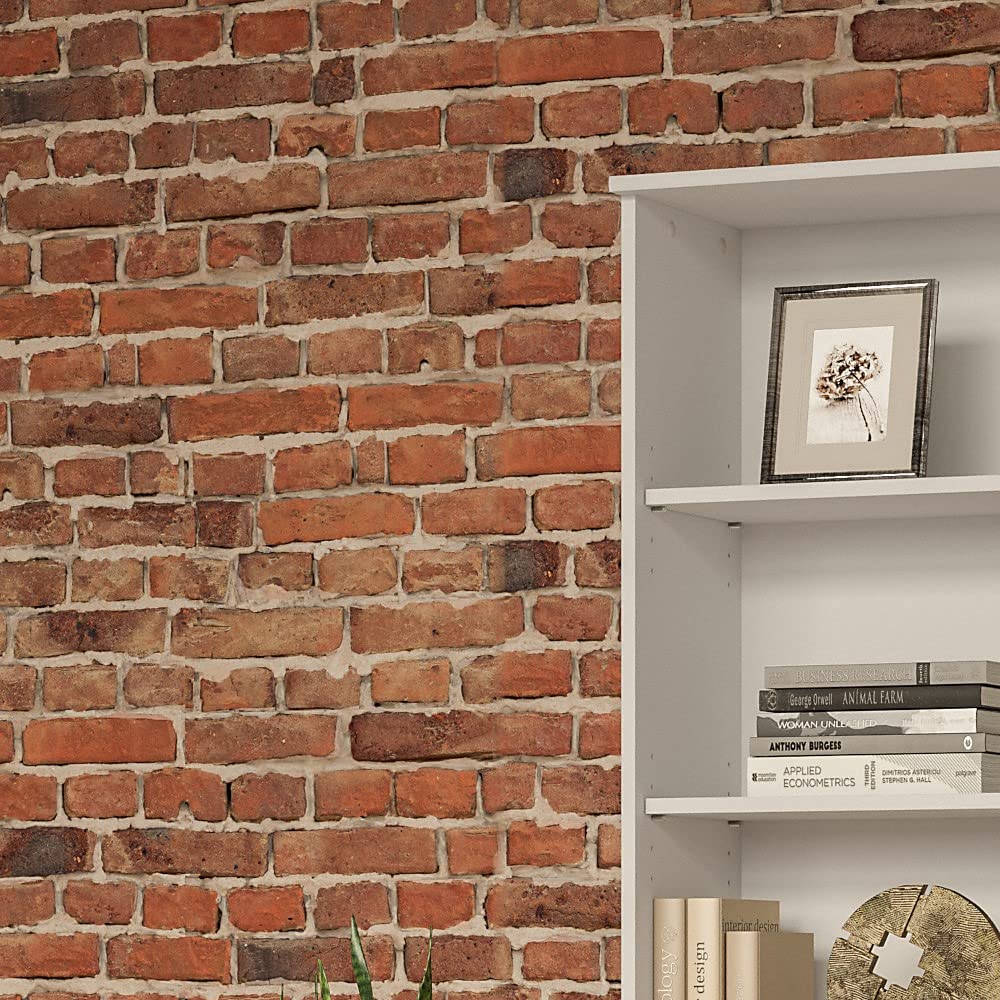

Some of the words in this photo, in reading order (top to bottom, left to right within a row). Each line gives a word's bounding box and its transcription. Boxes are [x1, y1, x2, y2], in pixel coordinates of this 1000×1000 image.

[796, 669, 849, 683] BUSINESS
[852, 666, 913, 682] RESEARCH
[789, 693, 812, 708] George
[813, 693, 833, 706] Orwell
[880, 690, 904, 704] FARM
[777, 720, 818, 729] WOMAN
[820, 719, 877, 729] UNLEASHED
[769, 741, 807, 751] ANTHONY
[809, 741, 842, 751] BURGESS
[783, 766, 822, 776] APPLIED
[783, 777, 856, 788] ECONOMETRICS
[722, 918, 752, 932] interior
[753, 918, 779, 933] design
[693, 941, 708, 994] design
